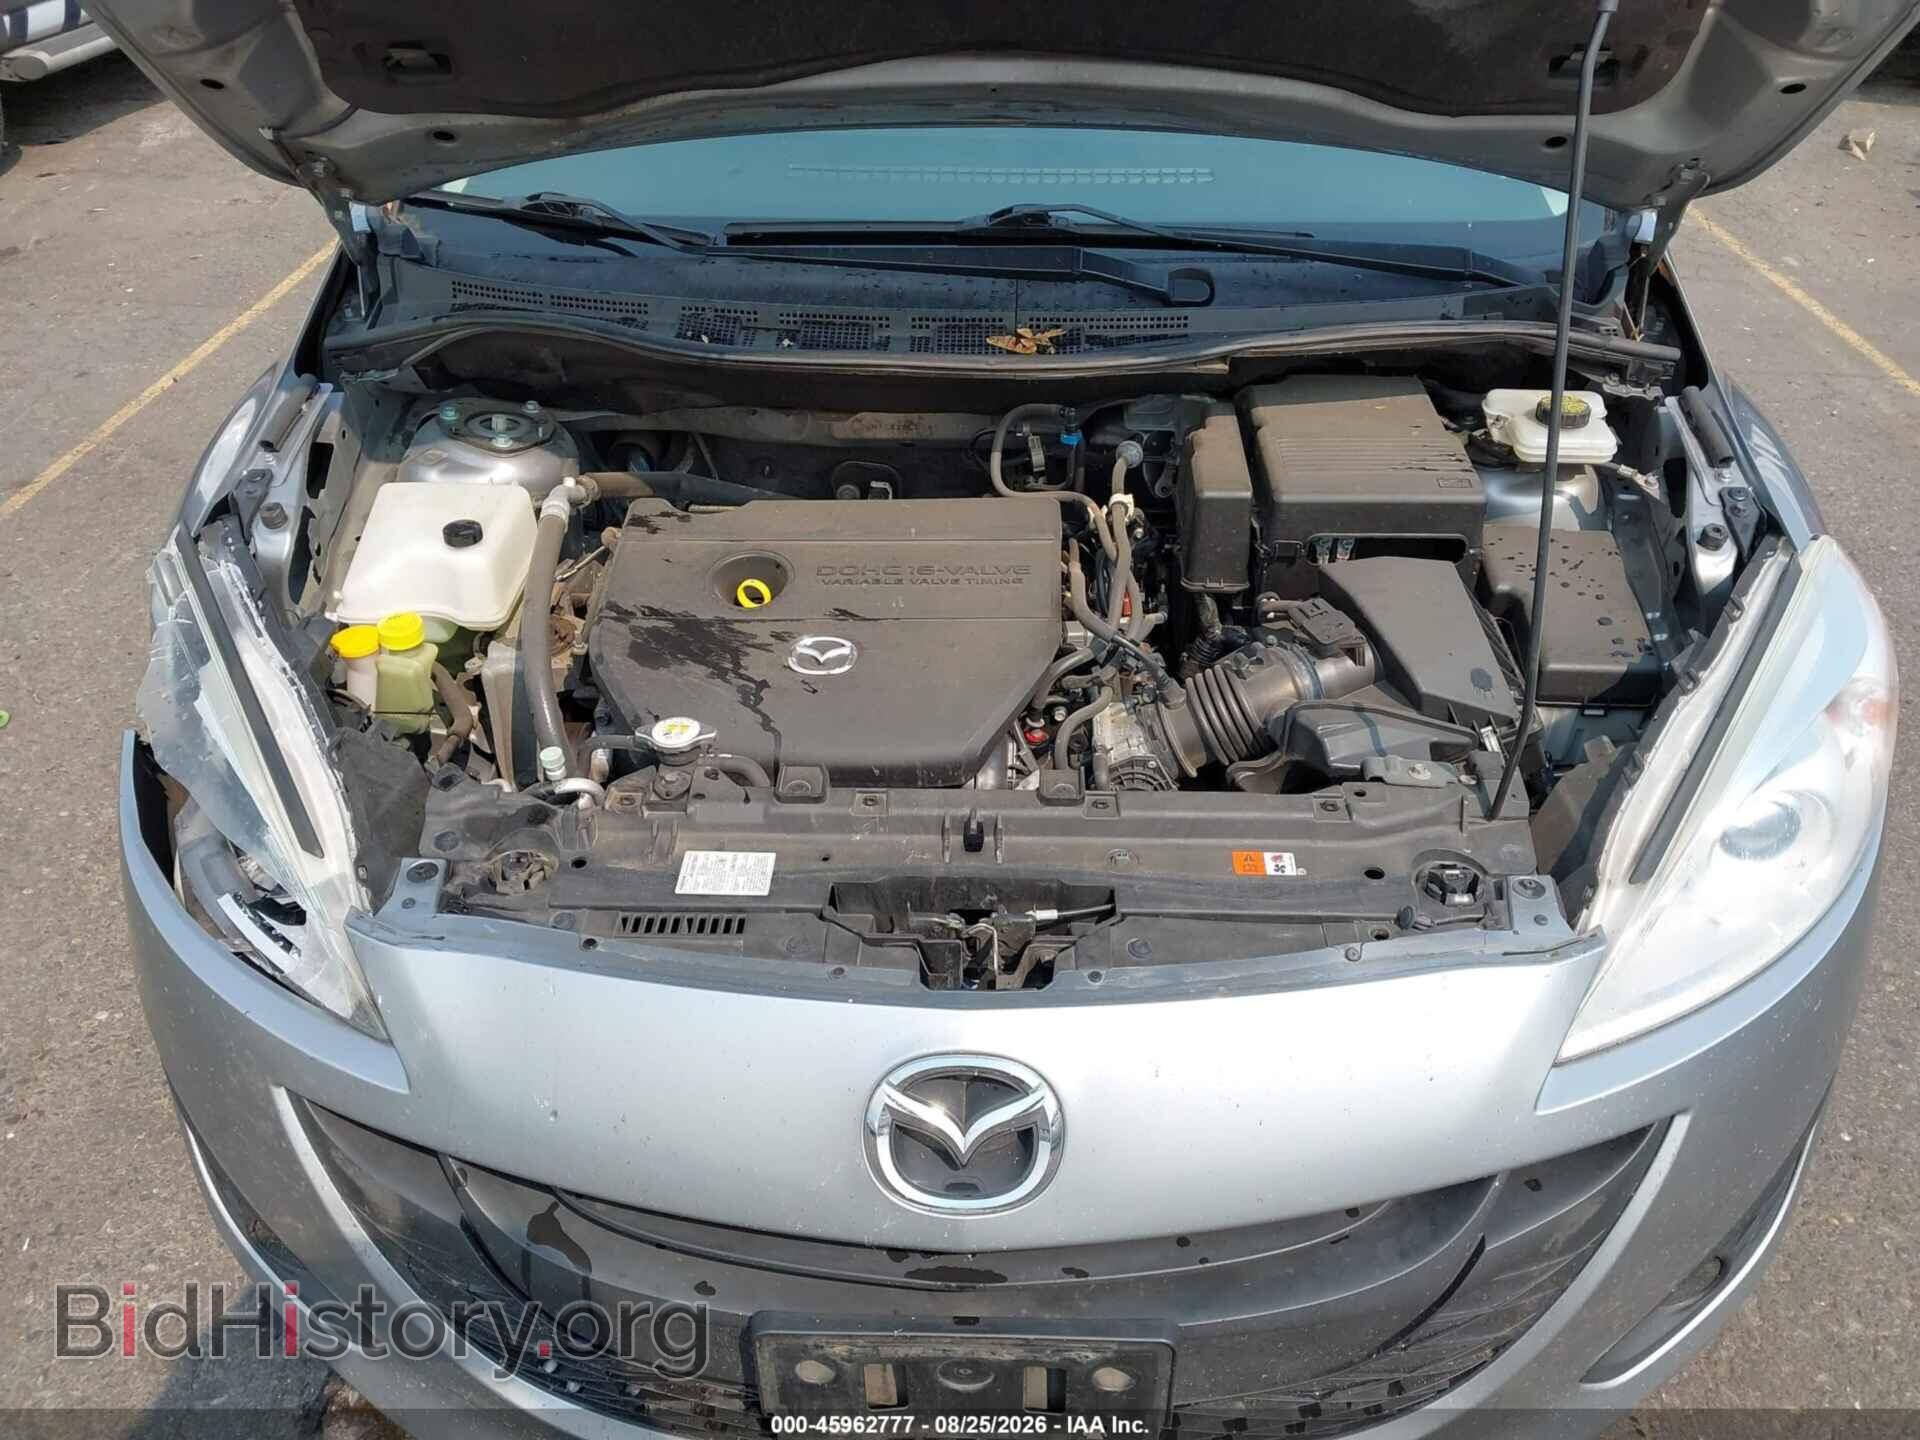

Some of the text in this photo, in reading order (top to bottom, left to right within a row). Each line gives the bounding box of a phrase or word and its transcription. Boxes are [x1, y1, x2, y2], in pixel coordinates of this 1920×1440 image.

[816, 565, 1032, 577] DOHC 16-VALVE
[820, 577, 1025, 586] VARIABLE VALVE TIMING
